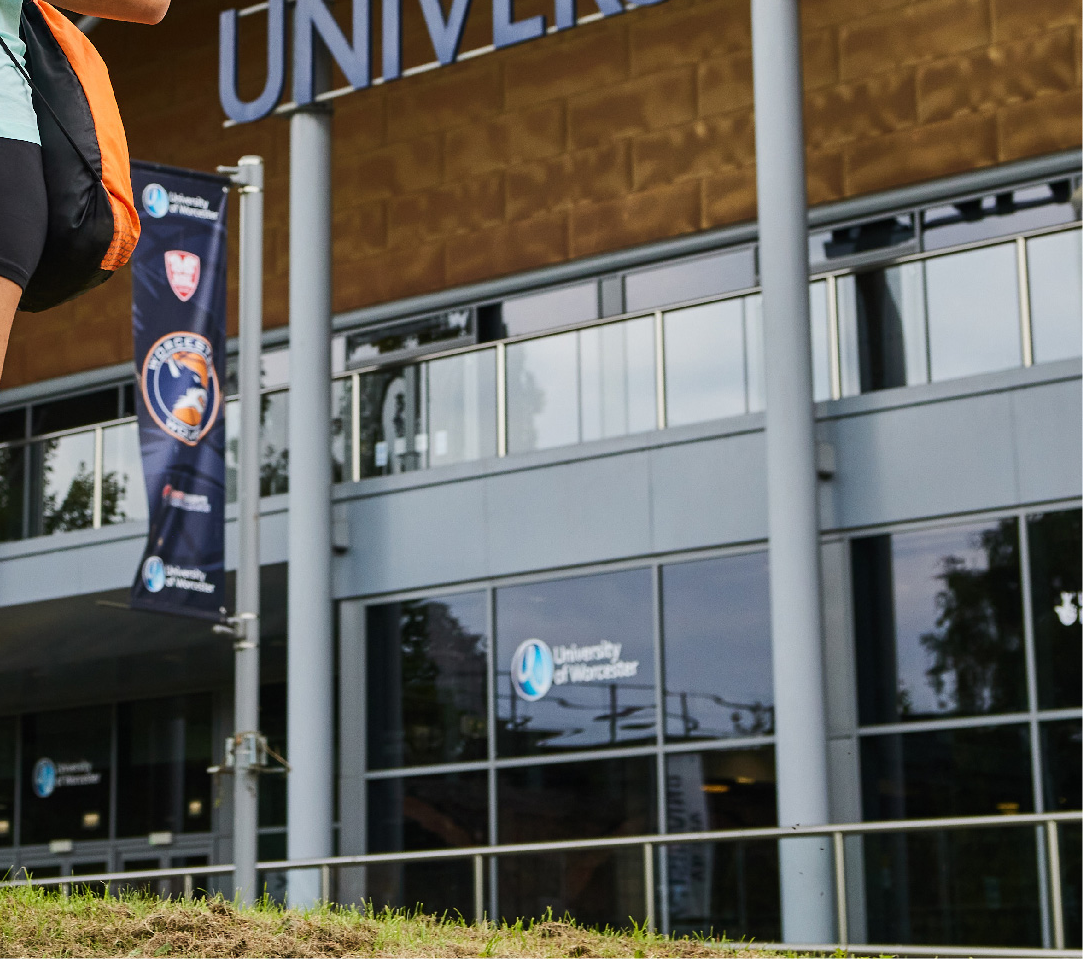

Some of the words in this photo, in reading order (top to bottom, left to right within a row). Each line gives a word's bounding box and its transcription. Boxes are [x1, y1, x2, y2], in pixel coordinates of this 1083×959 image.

[168, 191, 210, 210] University
[168, 203, 179, 214] of
[178, 204, 219, 221] Worcester
[164, 564, 207, 583] University
[175, 578, 216, 594] Worcester
[552, 639, 622, 666] University
[553, 662, 569, 685] of
[568, 660, 639, 683] Worcester
